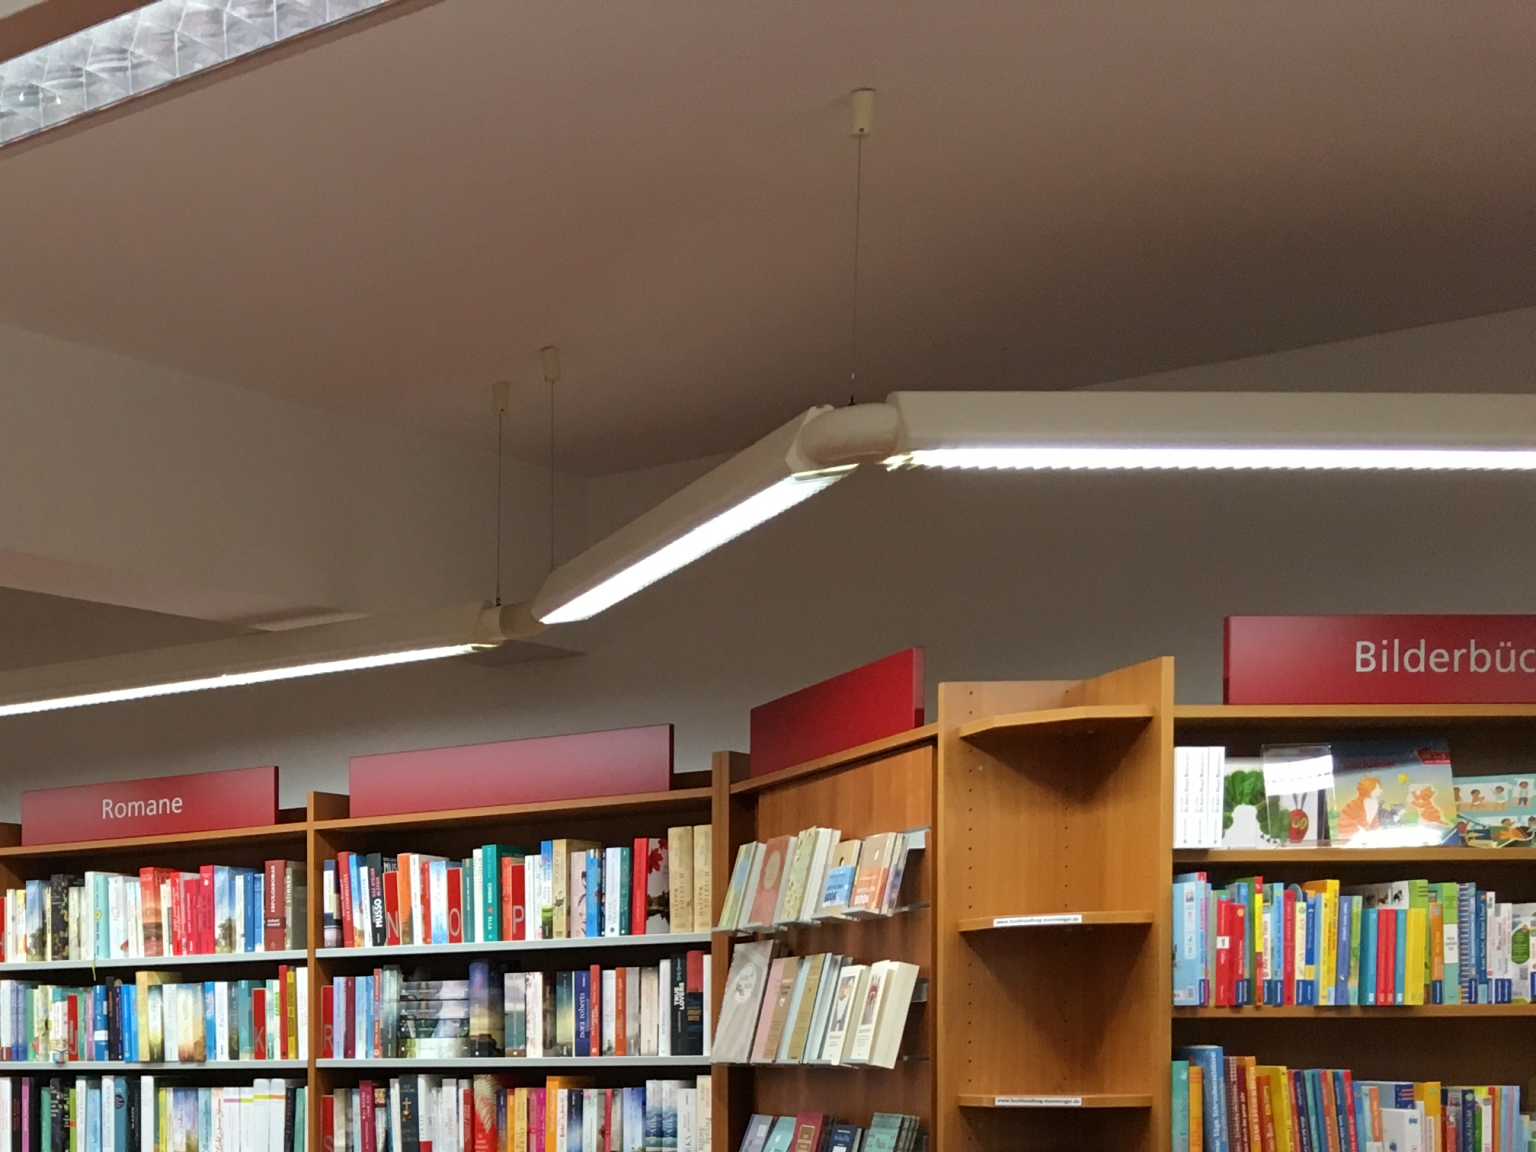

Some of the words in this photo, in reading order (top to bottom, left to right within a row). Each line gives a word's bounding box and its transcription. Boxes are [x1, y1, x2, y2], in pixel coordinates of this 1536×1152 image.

[102, 797, 184, 819] Romane
[373, 898, 383, 928] MUSSO
[386, 911, 400, 939] N
[449, 908, 461, 936] O
[512, 905, 525, 934] P
[254, 1026, 265, 1052] K
